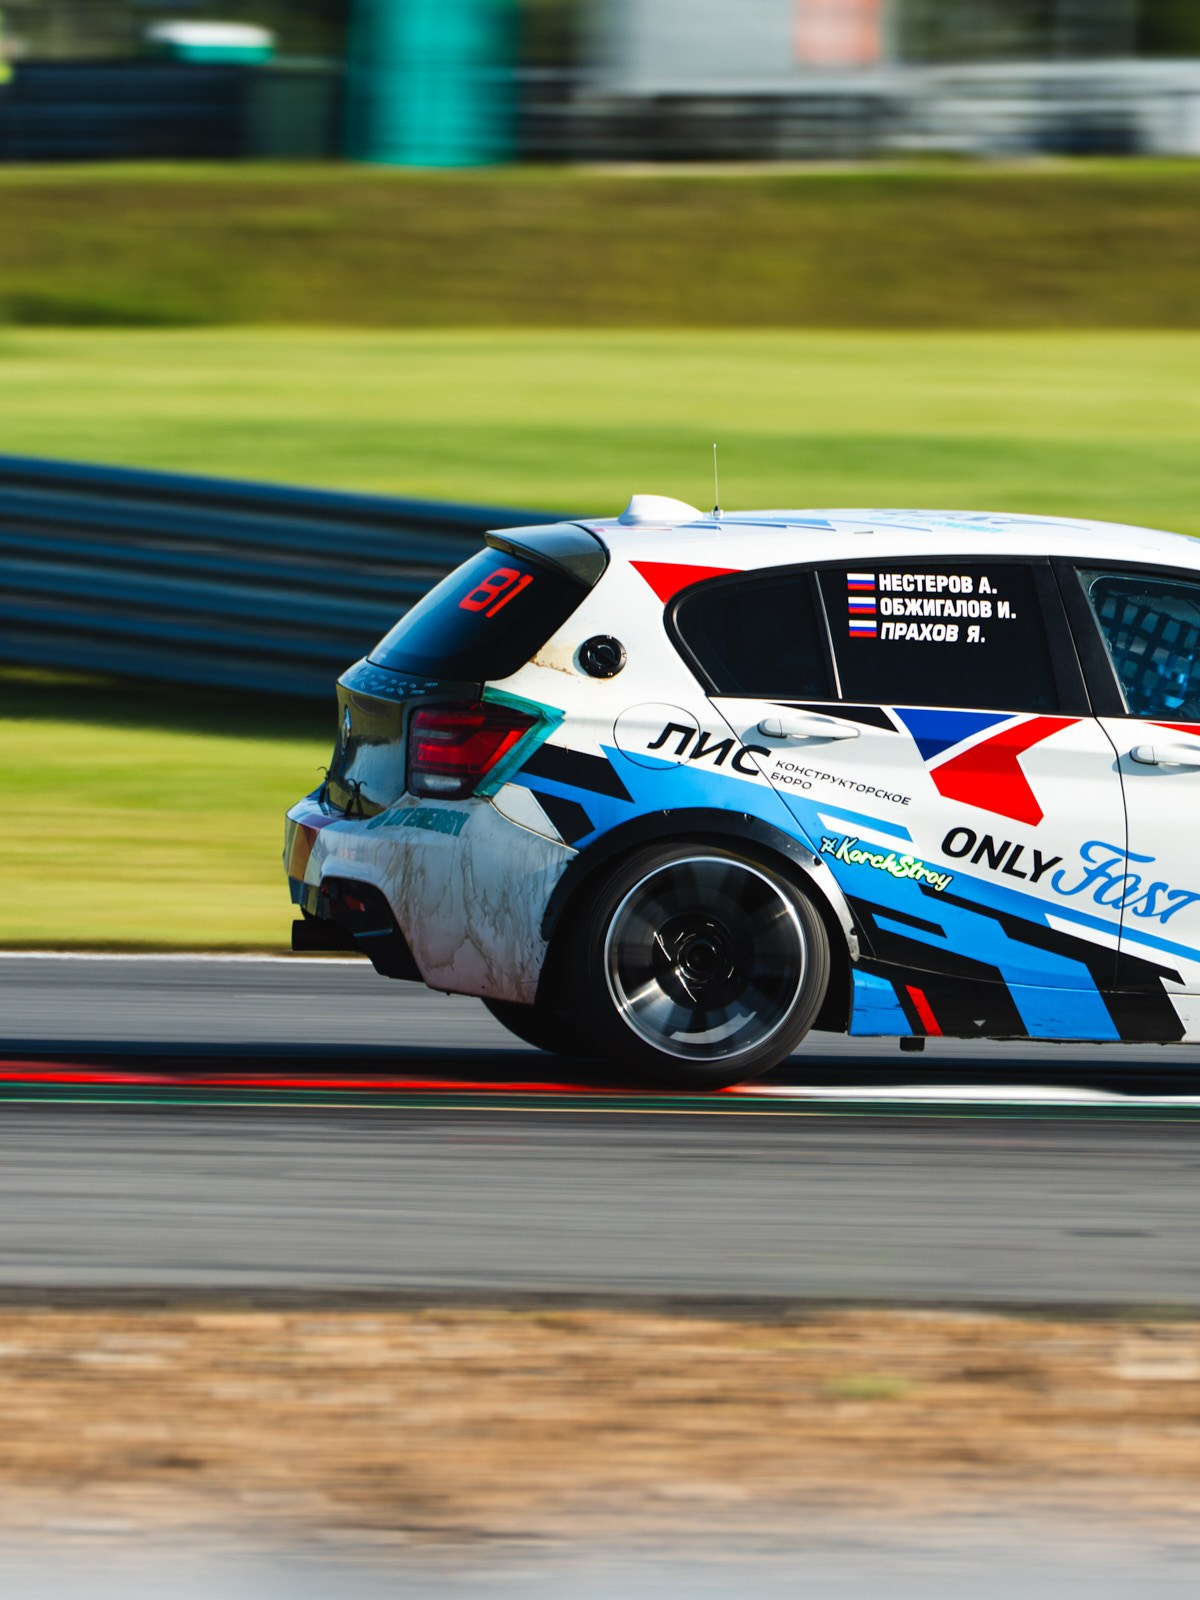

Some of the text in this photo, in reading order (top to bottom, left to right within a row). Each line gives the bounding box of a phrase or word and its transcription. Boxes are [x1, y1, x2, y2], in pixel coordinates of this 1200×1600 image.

[459, 567, 534, 618] 81
[879, 573, 998, 595] НЕСТЕРОВ А.
[880, 597, 1017, 619] ОБЖИГАЛОВ И.
[881, 622, 986, 643] ПРАХОВ Я.
[647, 722, 772, 776] ЛИС
[770, 771, 812, 790] БЮРО
[775, 759, 912, 806] КОНСТРУКТОРСКОЕ
[941, 827, 1063, 883] ONLY
